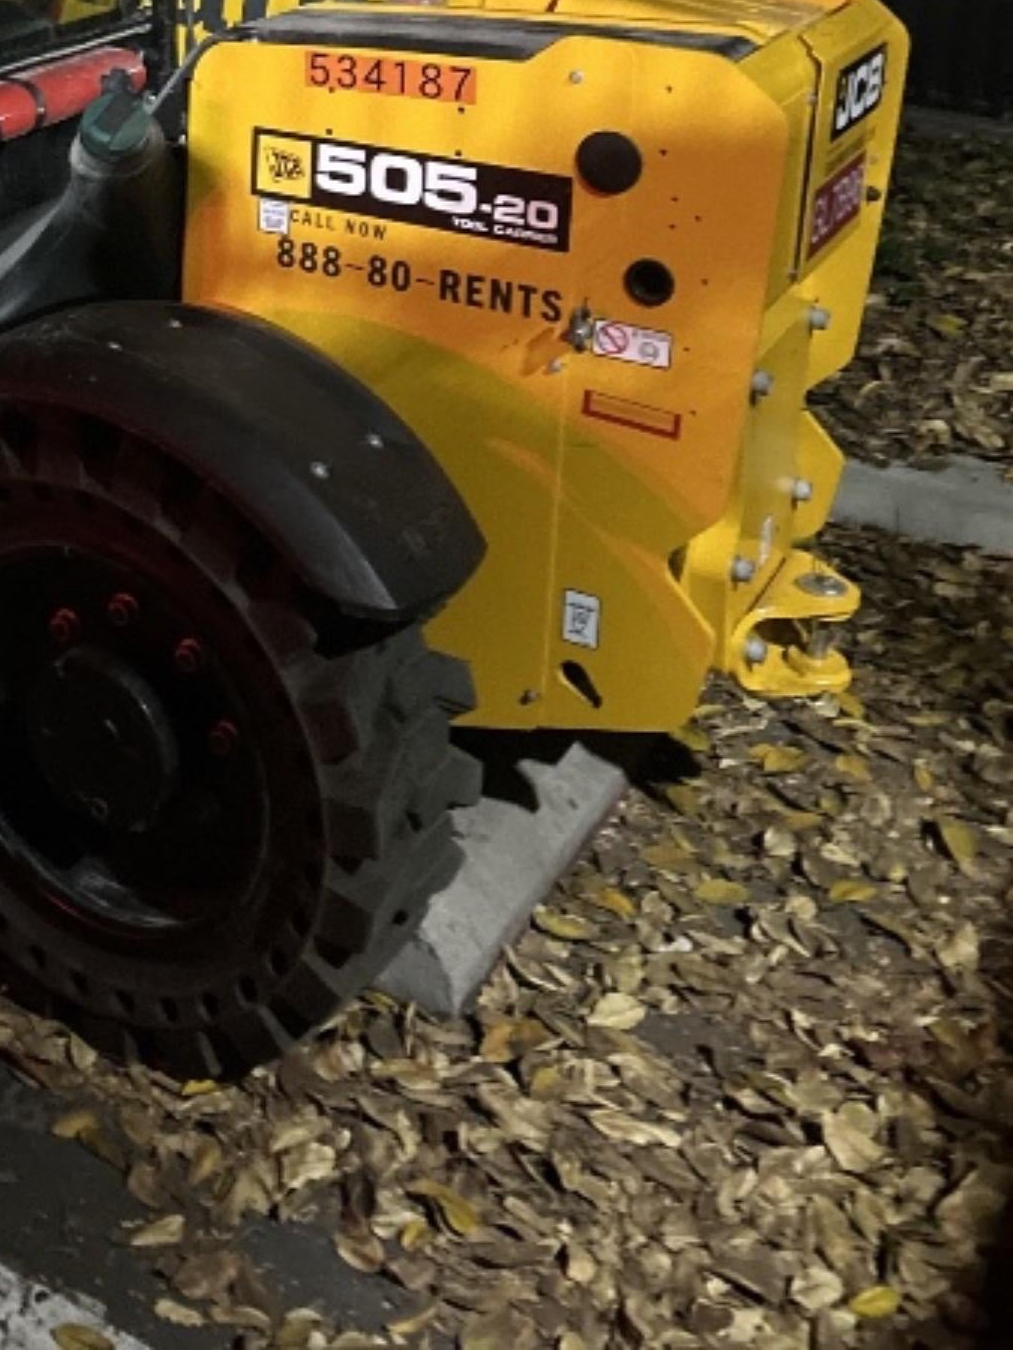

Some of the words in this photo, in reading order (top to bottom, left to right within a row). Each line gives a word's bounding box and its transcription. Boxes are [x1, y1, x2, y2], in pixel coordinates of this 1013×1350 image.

[310, 53, 471, 101] 534187
[836, 52, 885, 131] JCB
[290, 209, 335, 231] CALL
[344, 217, 387, 240] NOW
[277, 235, 564, 323] 888-80-RENTS
